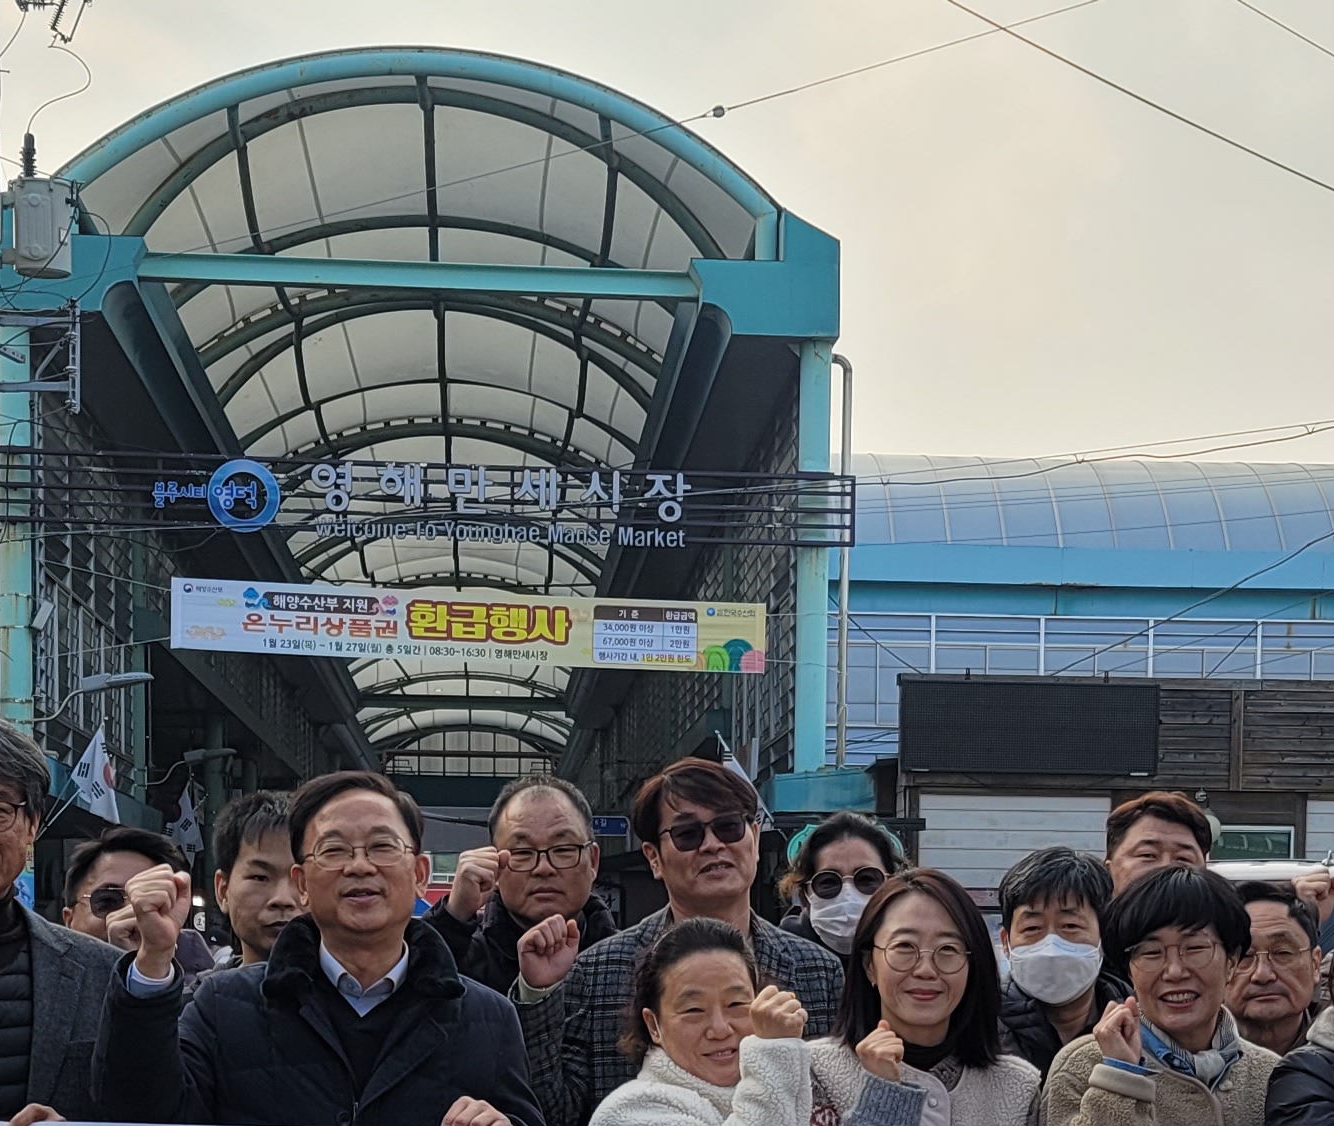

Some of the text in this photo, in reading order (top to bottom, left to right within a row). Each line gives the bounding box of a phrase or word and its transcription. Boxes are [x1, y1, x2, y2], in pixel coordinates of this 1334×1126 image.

[152, 480, 257, 510] 블루시티 영덕
[548, 524, 610, 545] Manse
[618, 527, 686, 548] Market
[272, 595, 369, 613] 해양수산부 지원
[241, 613, 398, 639] 온누리상품권
[407, 601, 570, 644] 환급행사
[397, 645, 421, 656] 5일간
